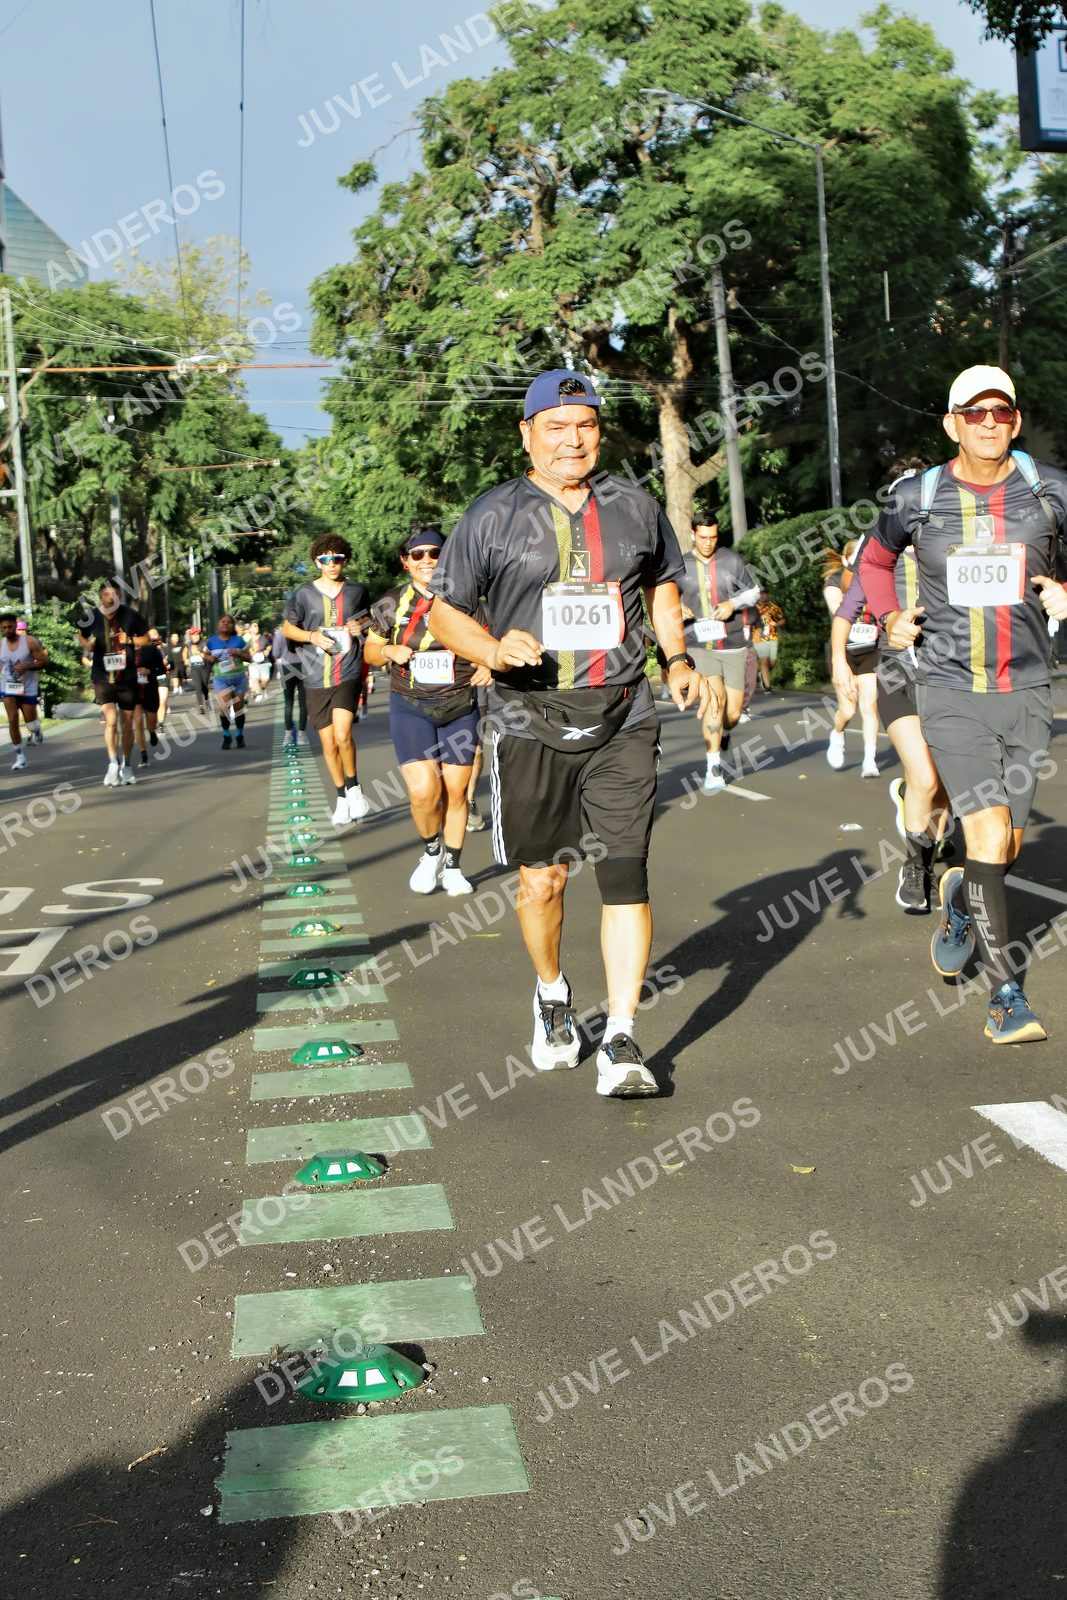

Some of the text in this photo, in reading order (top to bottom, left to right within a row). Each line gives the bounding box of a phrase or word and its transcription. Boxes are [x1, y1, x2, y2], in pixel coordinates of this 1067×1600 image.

[957, 565, 1008, 584] 8050
[547, 604, 612, 626] 10261
[413, 658, 449, 670] 10814
